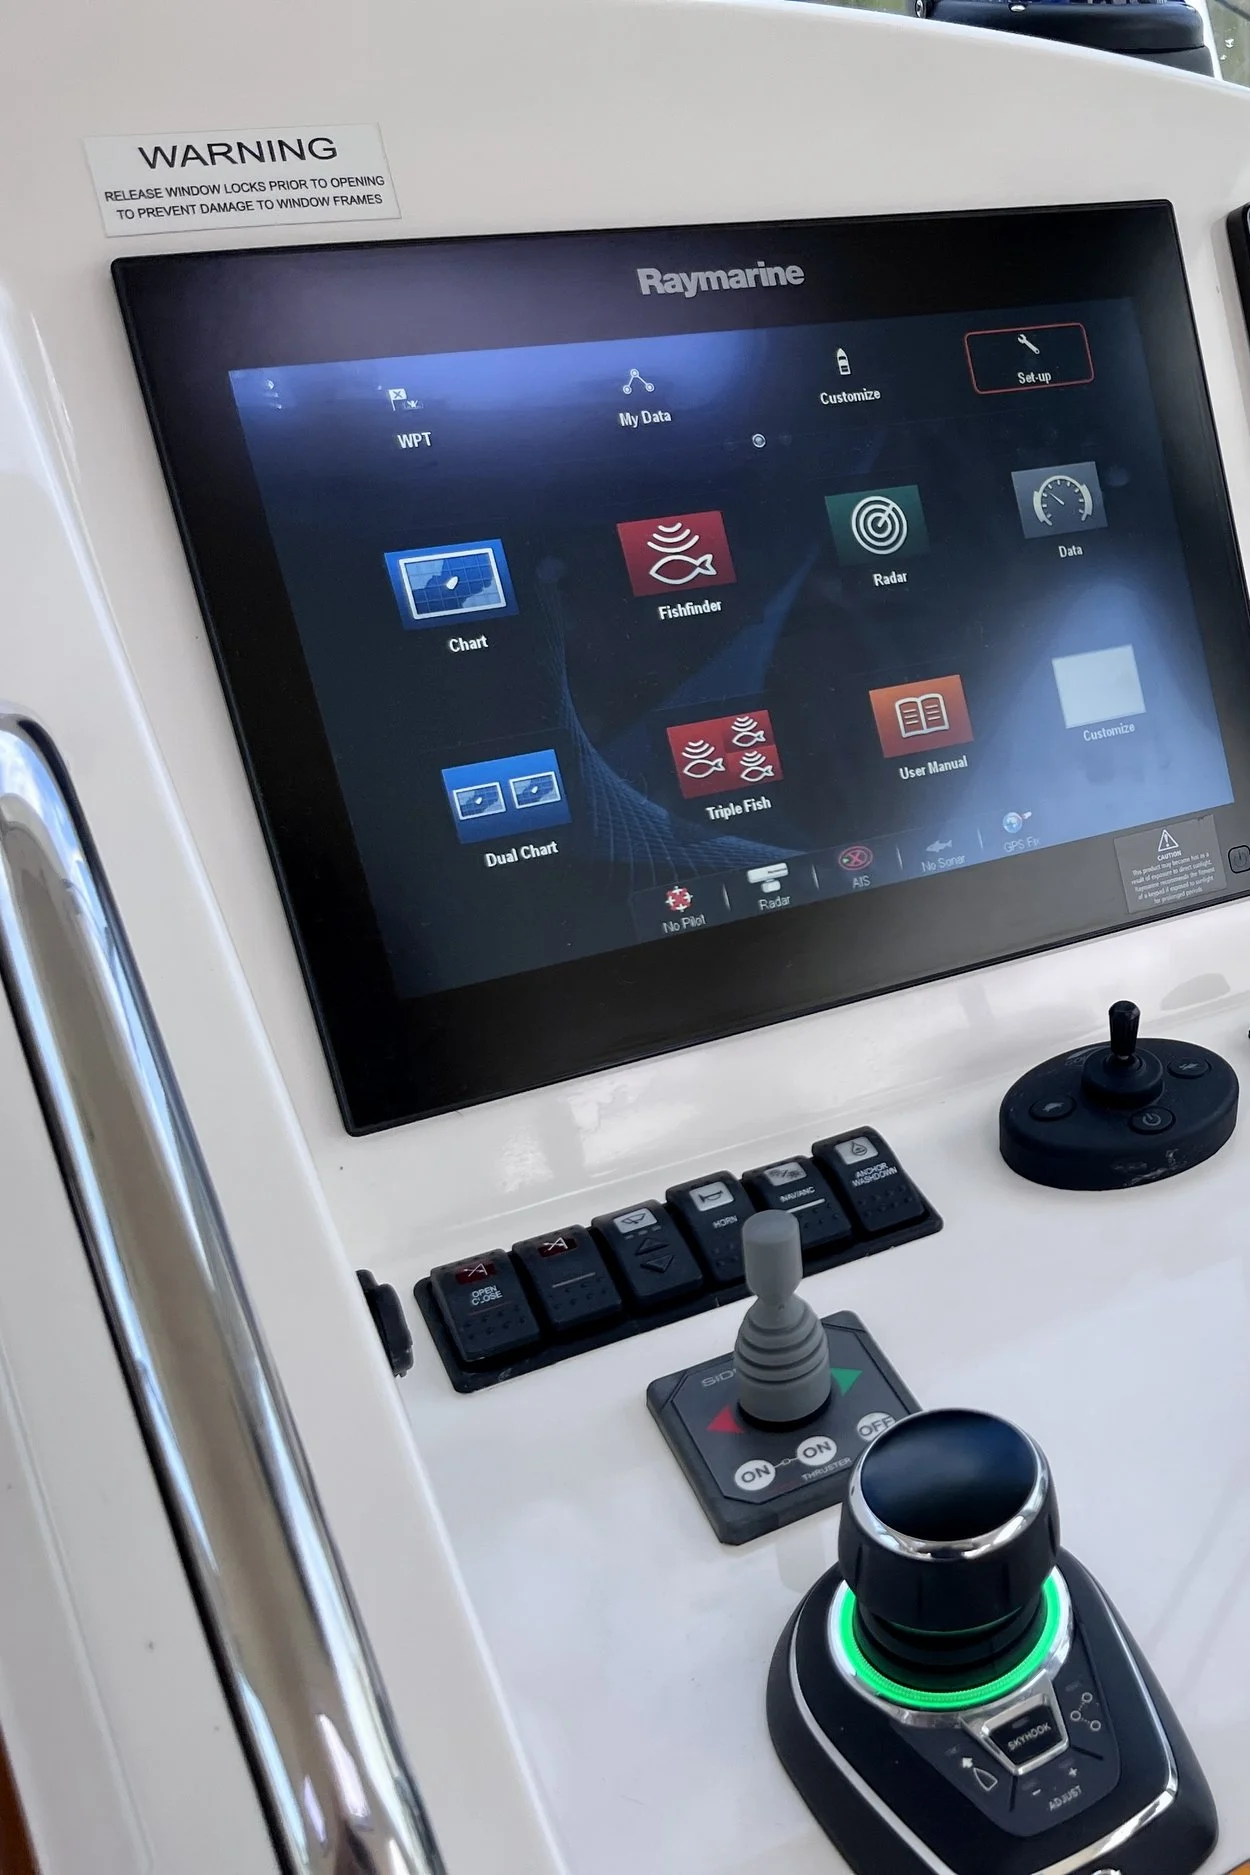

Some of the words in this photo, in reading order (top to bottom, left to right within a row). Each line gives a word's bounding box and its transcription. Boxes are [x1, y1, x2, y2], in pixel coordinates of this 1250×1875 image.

[138, 137, 338, 170] WARNING
[104, 187, 163, 203] RELEASE
[165, 183, 221, 198] WINDOW
[224, 180, 267, 195] LOCKS
[269, 178, 308, 193] PRIOR
[310, 177, 328, 190] TO
[330, 175, 385, 189] OPENING
[116, 208, 135, 221] TO
[137, 204, 197, 219] PREVENT
[200, 200, 255, 215] DAMAGE
[256, 198, 275, 211] TO
[277, 196, 330, 210] WINDOW
[333, 193, 384, 207] FRAMES
[637, 260, 805, 299] Raymarine
[1017, 370, 1052, 386] Set-up
[820, 387, 881, 406] Customize
[619, 410, 639, 429] My
[641, 408, 672, 426] Data
[397, 431, 433, 450] WPT
[1058, 543, 1083, 559] Data
[873, 570, 908, 587] Radar
[657, 598, 723, 622] Fishfinder
[448, 634, 489, 654] Chart
[1083, 722, 1136, 742] Customize
[900, 763, 928, 781] User
[928, 755, 968, 776] Manual
[706, 799, 743, 824] Triple
[743, 796, 772, 815] Fish
[485, 847, 519, 869] Dual
[520, 840, 559, 862] Chart
[1003, 837, 1024, 853] GPS
[921, 858, 940, 873] No
[941, 853, 966, 870] Sonar
[1157, 850, 1182, 861] CAUTION
[852, 874, 871, 889] AIS
[759, 894, 791, 912] Radar
[663, 918, 681, 934] No
[682, 914, 706, 931] Pilot
[851, 1166, 898, 1188] WASHDOWN
[855, 1161, 889, 1179] ANCHOR
[779, 1186, 816, 1203] NAV/ANC
[712, 1214, 739, 1229] HORN
[471, 1284, 498, 1300] OPEN
[858, 1416, 895, 1438] OFF
[802, 1441, 832, 1460] ON
[741, 1464, 771, 1484] ON
[801, 1456, 853, 1481] THRUSTER
[1007, 1722, 1052, 1752] SKYHOOK
[1049, 1784, 1082, 1812] ADJUST
